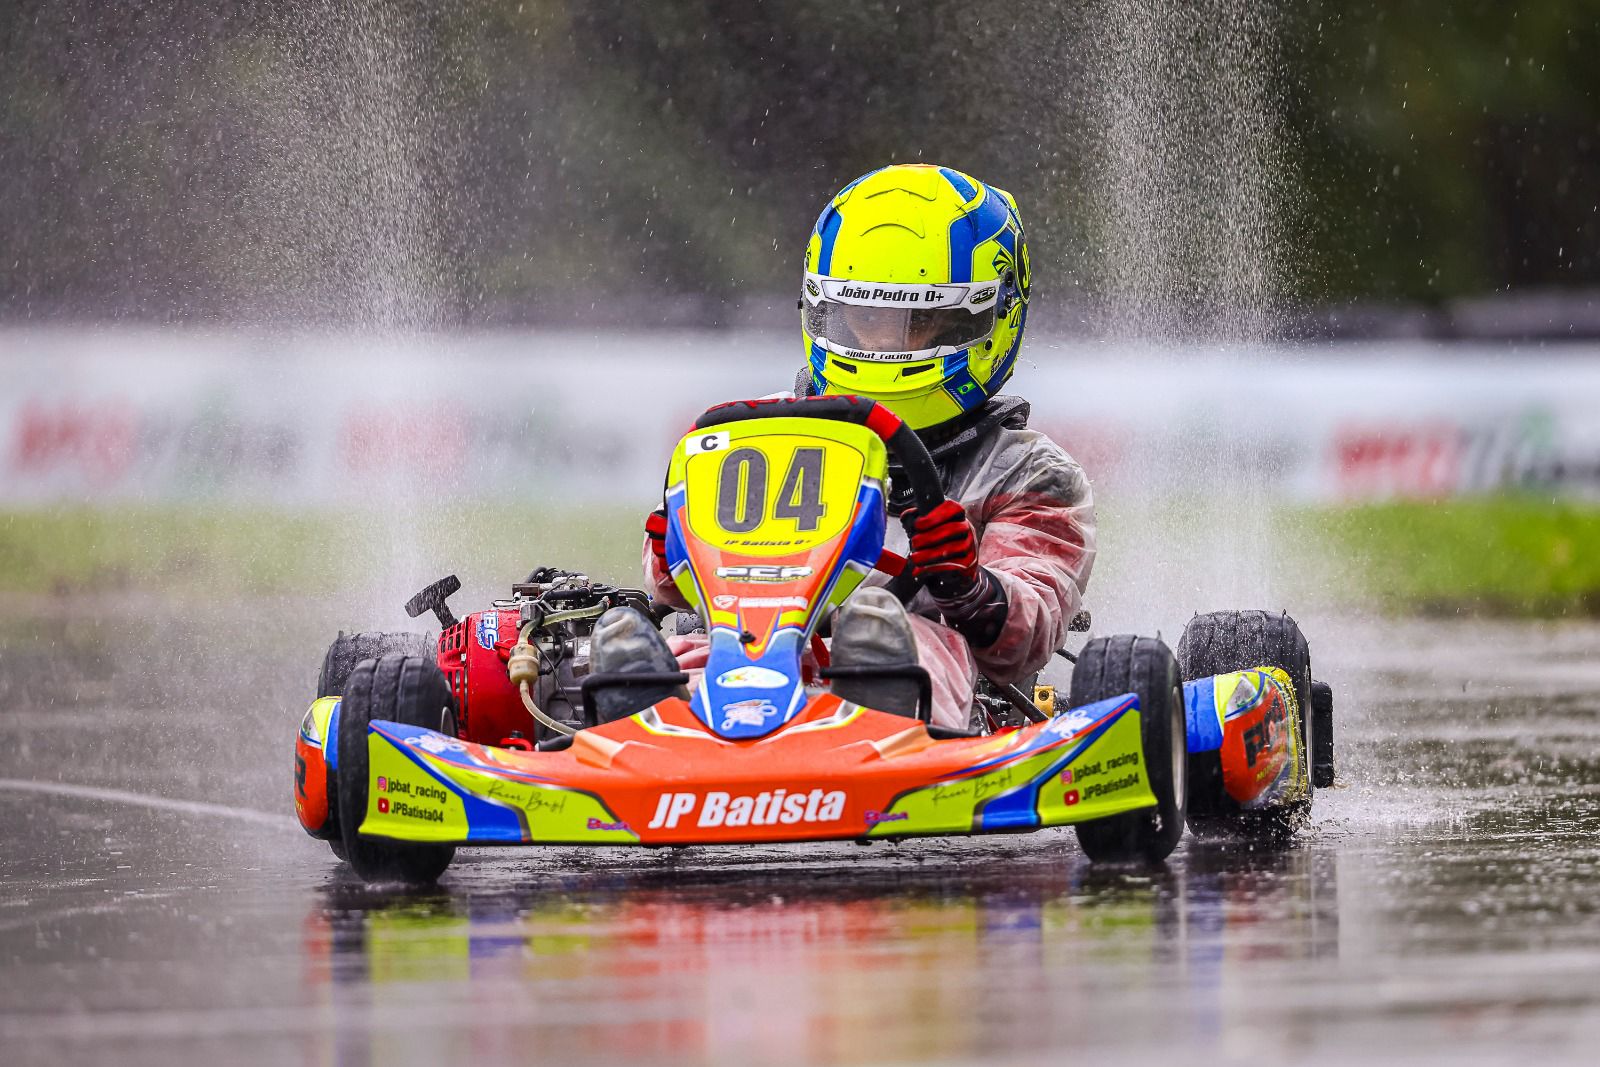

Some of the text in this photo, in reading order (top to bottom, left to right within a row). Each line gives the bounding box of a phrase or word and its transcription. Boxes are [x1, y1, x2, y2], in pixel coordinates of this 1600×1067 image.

[837, 285, 869, 299] João
[872, 288, 919, 302] Pedro
[970, 286, 996, 303] PCR
[700, 435, 718, 451] C
[714, 446, 827, 534] 04
[1073, 752, 1139, 783] jpbat_racing
[387, 777, 447, 804] jpbat_racing
[1082, 772, 1139, 801] JPBatista04
[391, 801, 444, 823] JPBatista04
[647, 788, 847, 829] JP Batista
